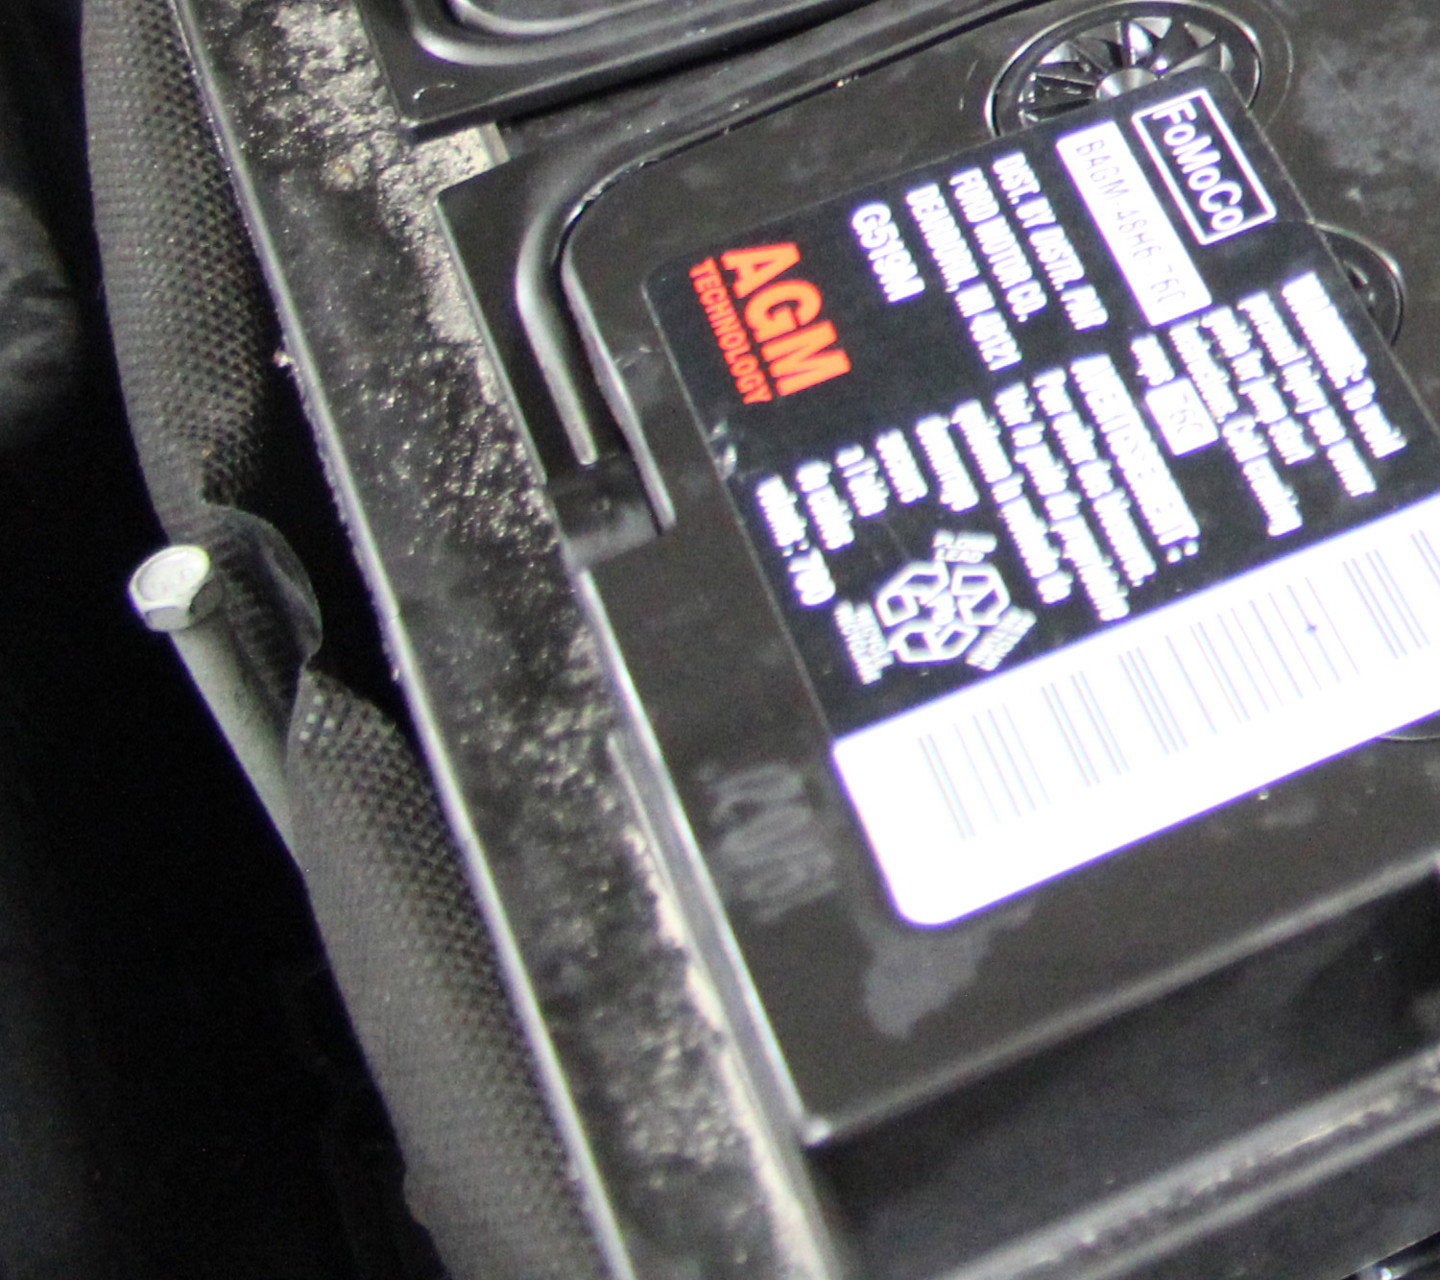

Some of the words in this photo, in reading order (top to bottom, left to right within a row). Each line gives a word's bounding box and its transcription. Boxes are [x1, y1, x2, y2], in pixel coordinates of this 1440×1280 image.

[948, 166, 1002, 223] FORD
[991, 151, 1045, 205] DIST.
[1147, 99, 1259, 234] FoMoCo
[1014, 194, 1057, 231] BY
[850, 200, 925, 302] G519M
[972, 213, 1033, 289] MOTOR
[688, 256, 774, 404] TECHNOLOGY
[718, 241, 852, 396] AGM
[1004, 278, 1047, 322] CO.
[1059, 283, 1109, 330] PAR
